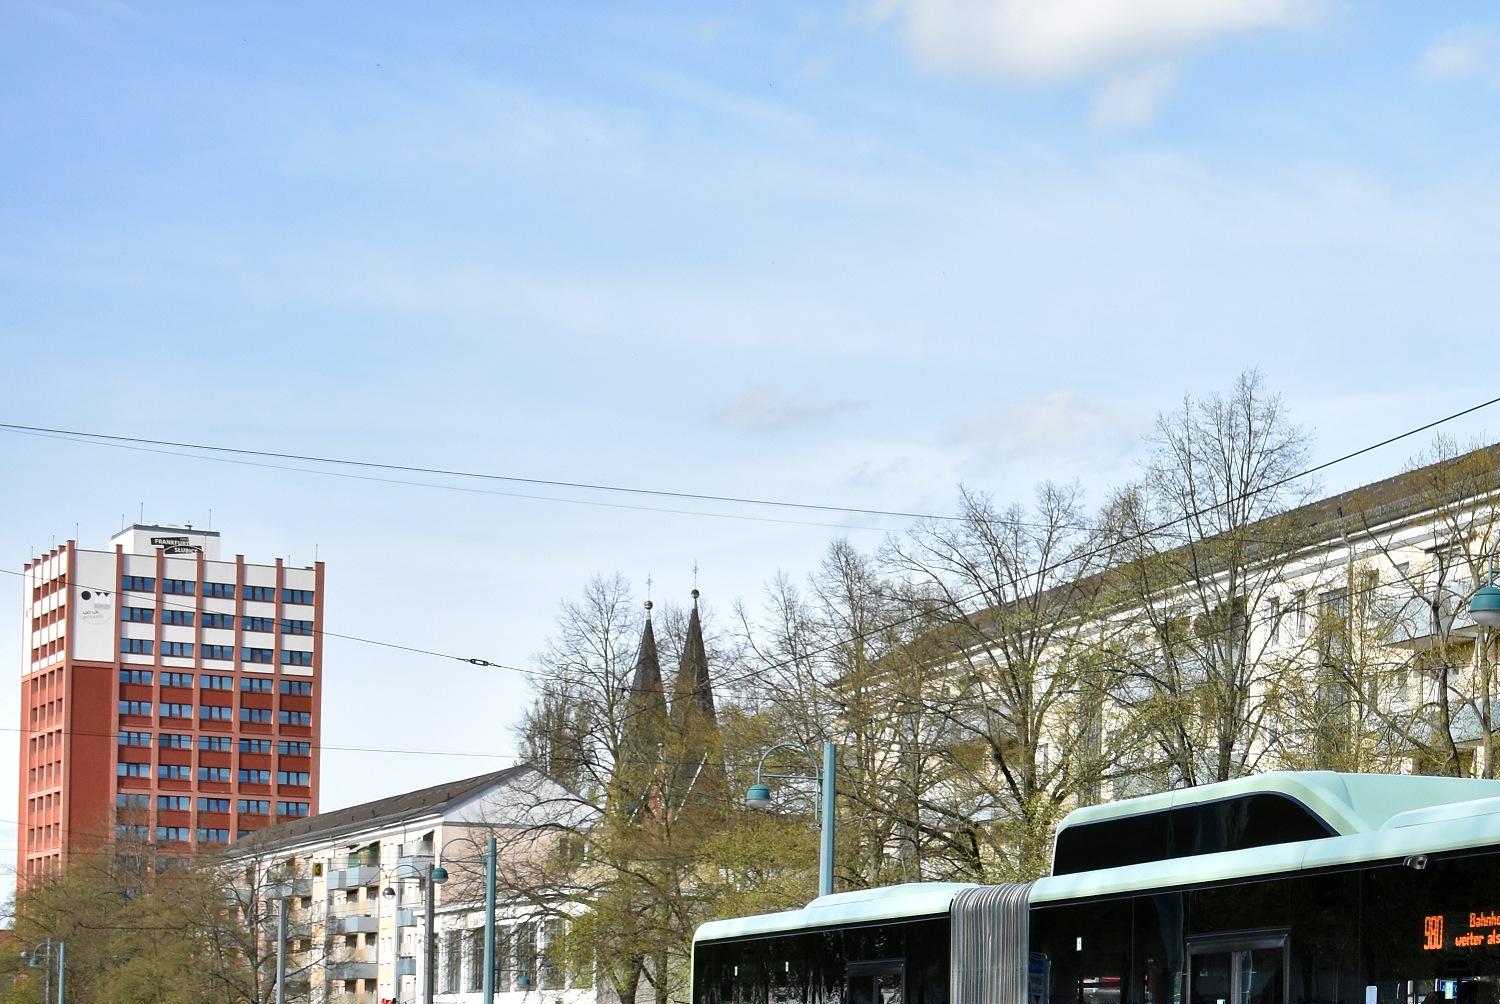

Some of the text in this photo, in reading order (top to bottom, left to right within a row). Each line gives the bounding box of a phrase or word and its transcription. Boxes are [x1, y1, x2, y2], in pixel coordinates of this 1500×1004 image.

[1424, 916, 1443, 950] 980
[1455, 932, 1484, 946] weiter
[1487, 929, 1500, 945] als
